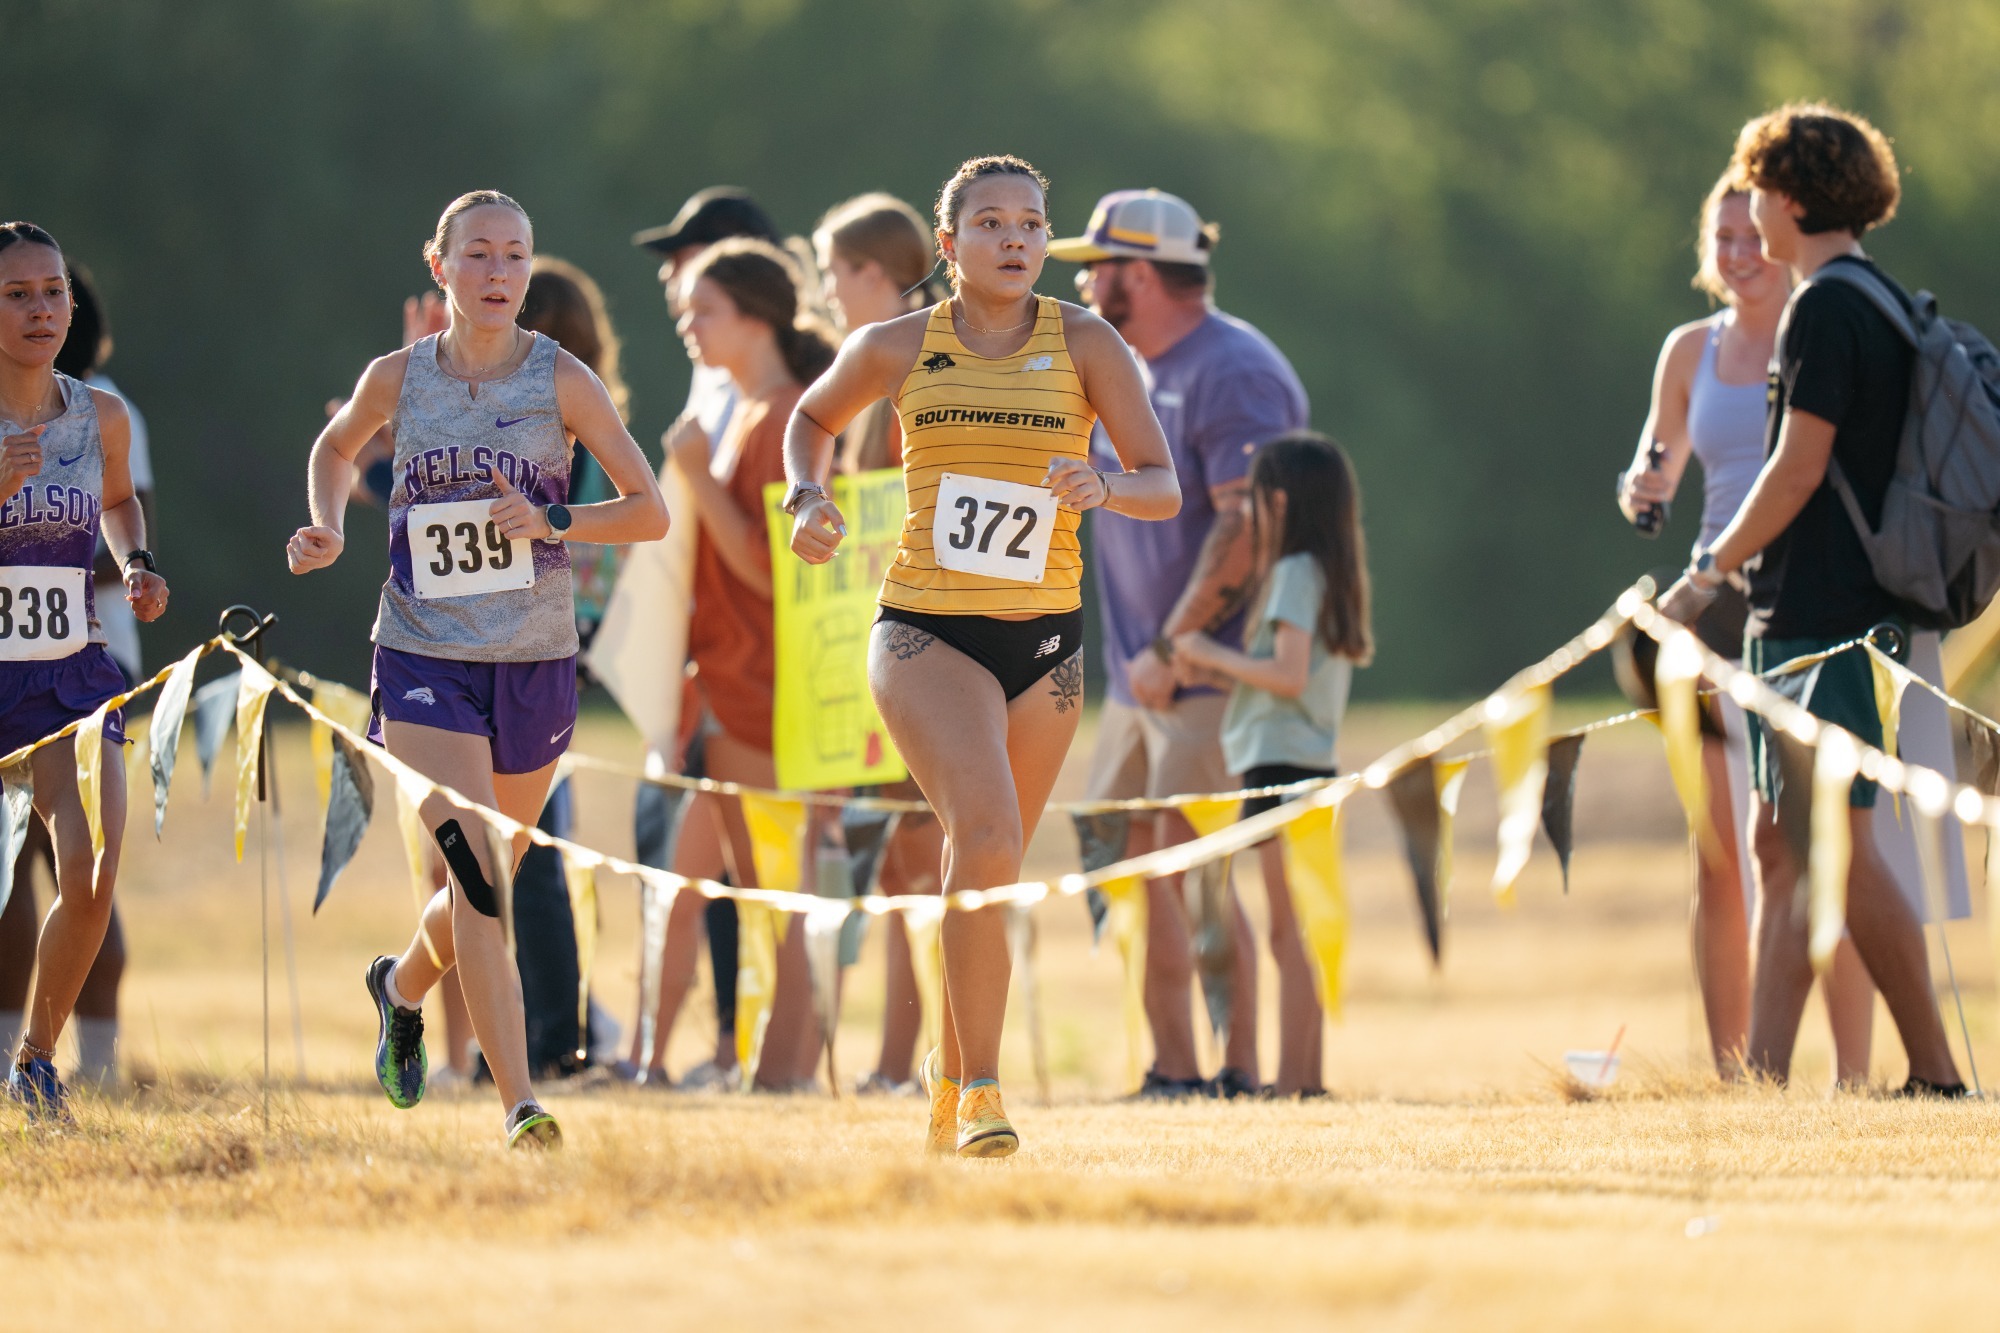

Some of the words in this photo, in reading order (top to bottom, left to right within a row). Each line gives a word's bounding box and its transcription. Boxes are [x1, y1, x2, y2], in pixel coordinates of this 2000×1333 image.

[915, 409, 1066, 430] SOUTHWESTERN
[404, 445, 541, 502] NELSON
[0, 484, 99, 535] ELSON
[948, 496, 1038, 560] 372
[426, 521, 513, 577] 339
